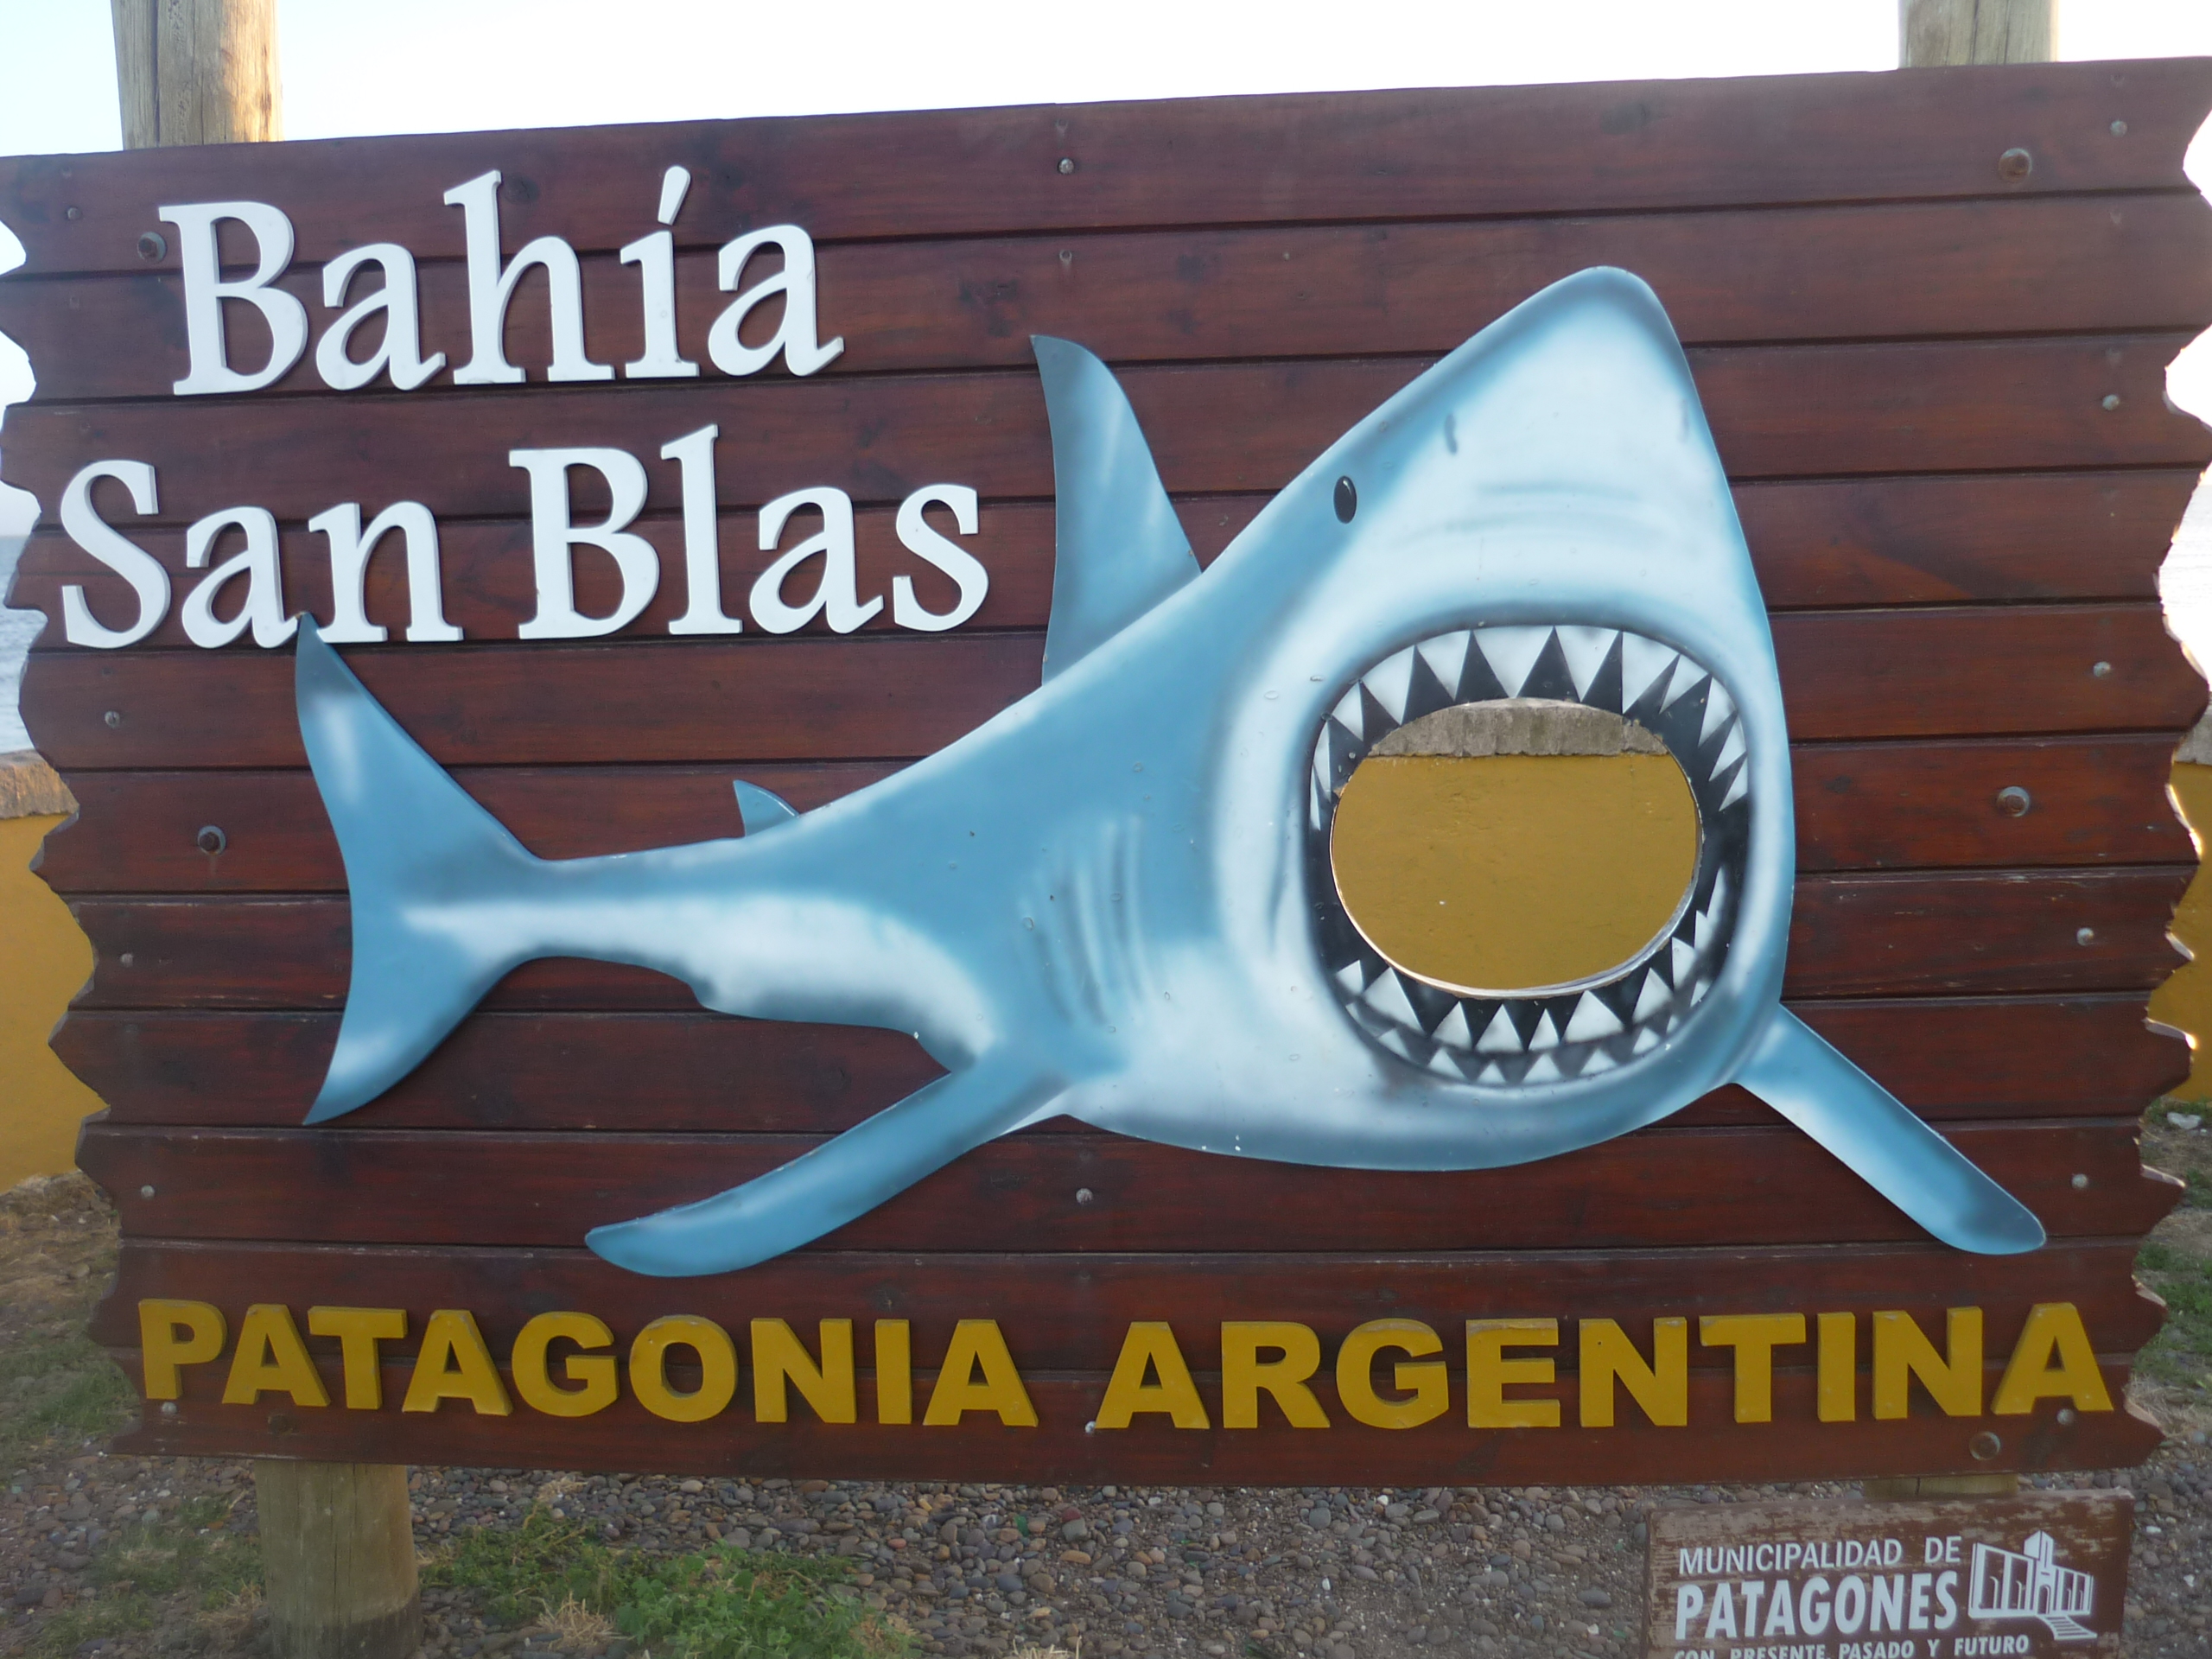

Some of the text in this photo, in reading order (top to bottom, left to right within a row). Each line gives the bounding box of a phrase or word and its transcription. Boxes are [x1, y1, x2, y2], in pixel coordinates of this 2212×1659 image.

[158, 164, 844, 395] Bahía
[60, 423, 989, 649] San Blas
[138, 1299, 2113, 1429] PATAGONIA ARGENTINA
[1675, 1570, 1958, 1639] PATAGONES
[1678, 1535, 1962, 1575] MUNICIPALIDAD DE
[1838, 1639, 1915, 1659] PASADO
[1927, 1638, 1940, 1657] Y
[1953, 1635, 2030, 1656] FUTURO
